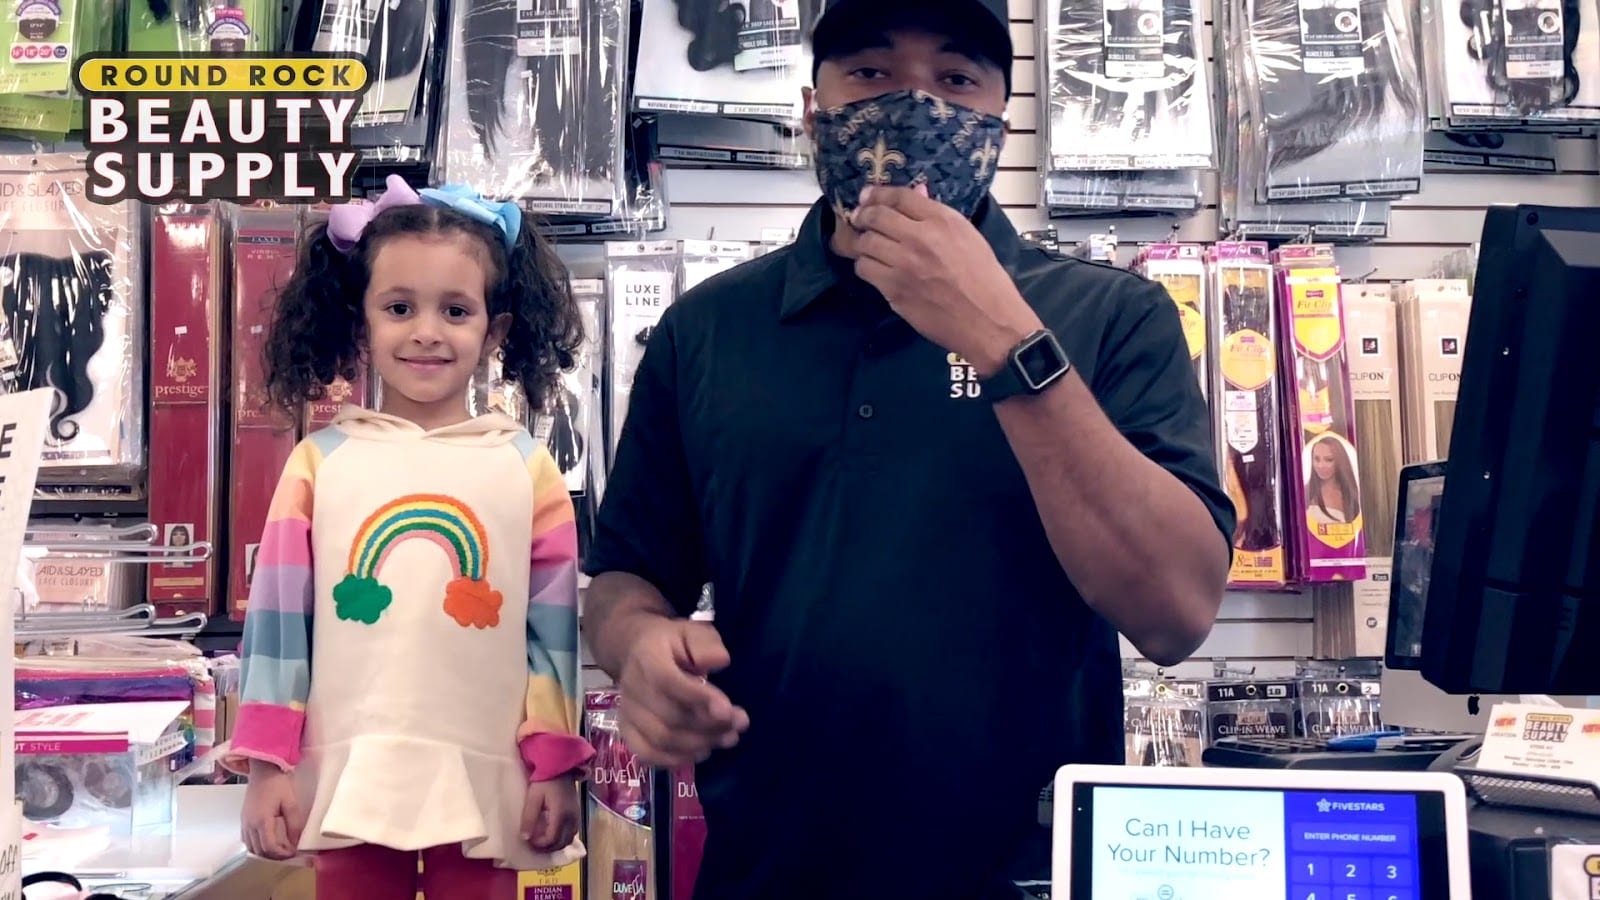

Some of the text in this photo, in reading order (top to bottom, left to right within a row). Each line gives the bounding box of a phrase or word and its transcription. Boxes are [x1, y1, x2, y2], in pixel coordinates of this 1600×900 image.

[1186, 248, 1193, 256] 1
[625, 284, 661, 295] LUXE
[625, 297, 661, 307] LINE
[155, 385, 205, 397] prestige
[1218, 687, 1235, 697] 11A
[1312, 683, 1328, 693] 11A
[1526, 721, 1569, 732] BEAUTY
[1524, 732, 1567, 742] SUPPLY
[1332, 802, 1385, 811] FIVESTARS
[1125, 817, 1250, 840] Can I Have
[1304, 832, 1396, 842] ENTER PHONE NUMBER
[1108, 843, 1271, 867] Your Number?
[1307, 863, 1397, 879] 1 2 3
